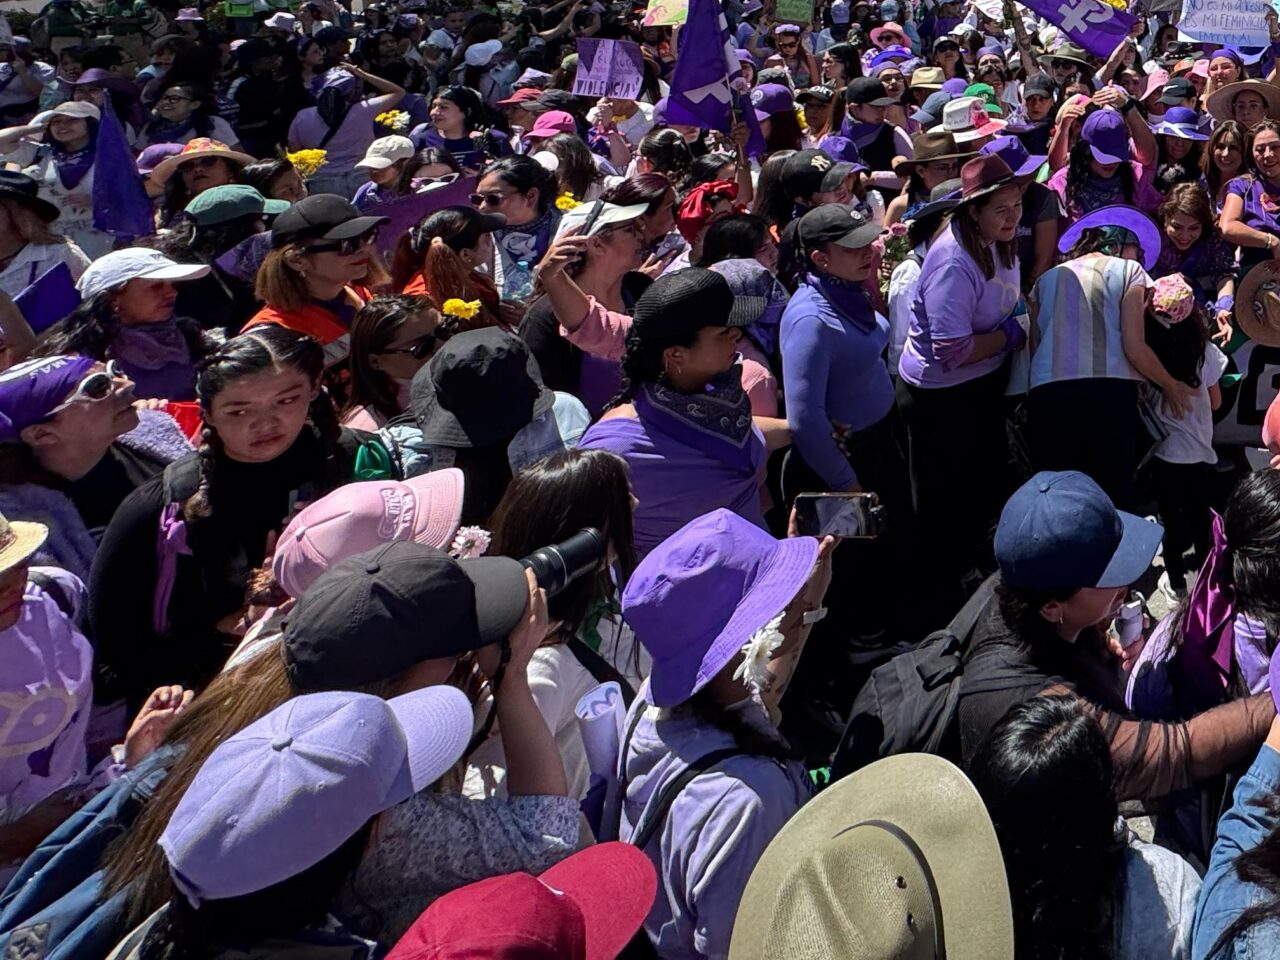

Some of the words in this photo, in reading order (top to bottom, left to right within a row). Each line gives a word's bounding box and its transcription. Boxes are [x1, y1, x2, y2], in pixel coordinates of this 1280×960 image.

[1184, 12, 1198, 28] ES
[1203, 13, 1217, 27] MI
[576, 79, 631, 98] VIOLENCIA
